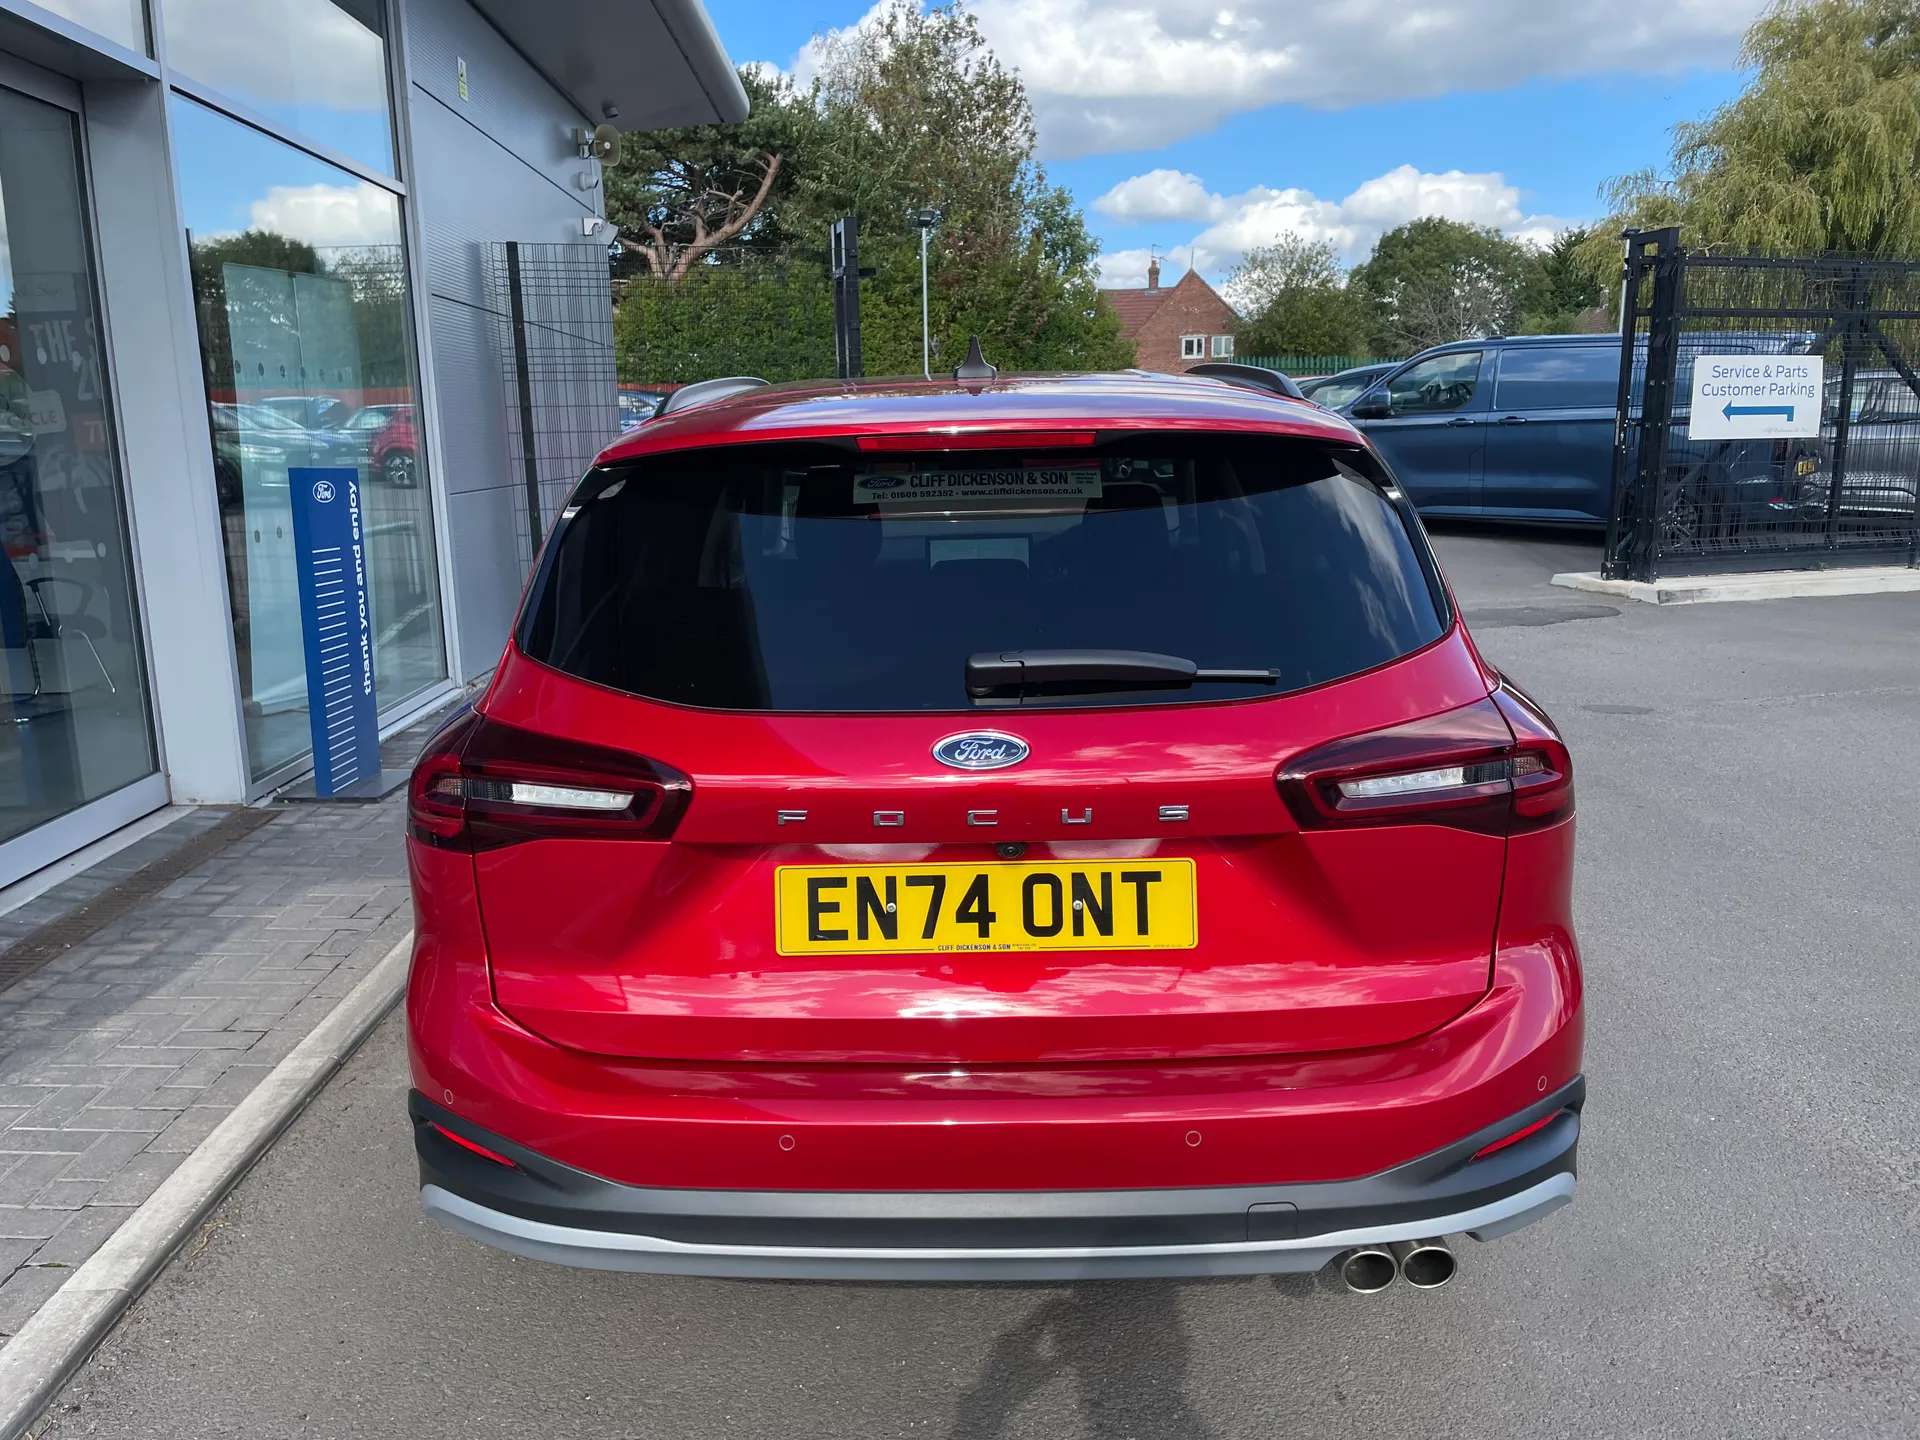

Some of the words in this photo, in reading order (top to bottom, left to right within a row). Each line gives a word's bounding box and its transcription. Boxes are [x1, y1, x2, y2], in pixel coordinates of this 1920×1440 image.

[1712, 365, 1760, 378] Service
[1763, 365, 1772, 378] &
[1776, 365, 1808, 378] Parts
[1701, 383, 1766, 396] Customer
[1769, 382, 1815, 398] Parking
[910, 473, 946, 488] CLIFF
[948, 472, 1024, 487] DICKENSON
[1027, 472, 1038, 485] &
[1041, 472, 1069, 486] SON
[872, 491, 889, 500] Tel:
[961, 486, 1083, 497] www.cliffdickenson.co.uk
[348, 480, 360, 541] enjoy
[352, 544, 363, 586] and
[358, 590, 368, 630] you
[360, 632, 372, 696] thank
[954, 739, 1007, 761] Ford
[777, 805, 1189, 826] FOCUS
[807, 873, 997, 942] EN74
[1021, 870, 1163, 938] ONT
